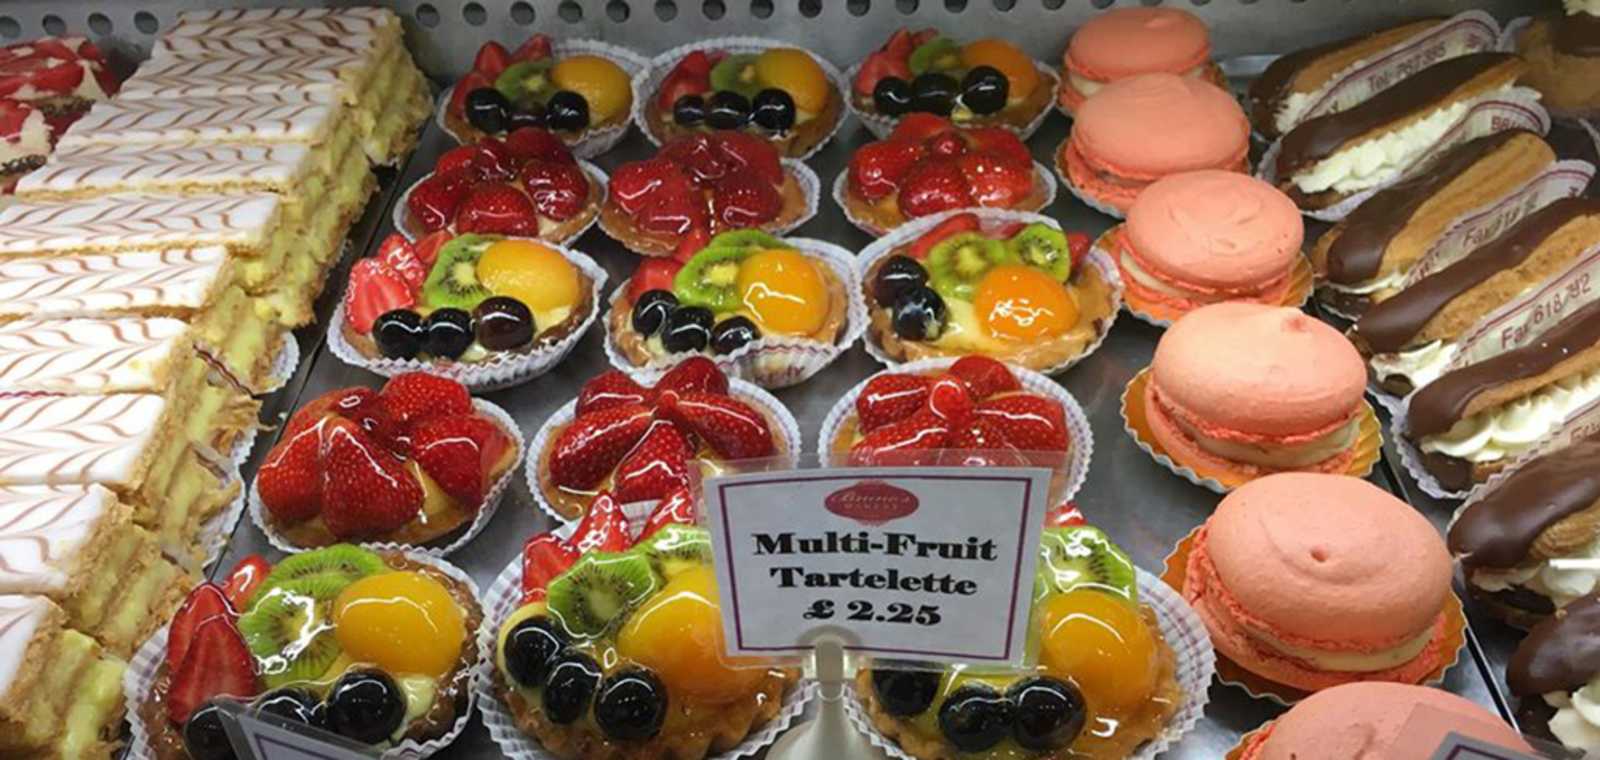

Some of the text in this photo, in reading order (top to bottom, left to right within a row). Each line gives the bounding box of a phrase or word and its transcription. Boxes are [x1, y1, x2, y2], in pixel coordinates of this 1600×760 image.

[751, 531, 998, 561] Multi-Fruit
[769, 566, 978, 595] Tartelette
[802, 600, 942, 626] £ 2.25
